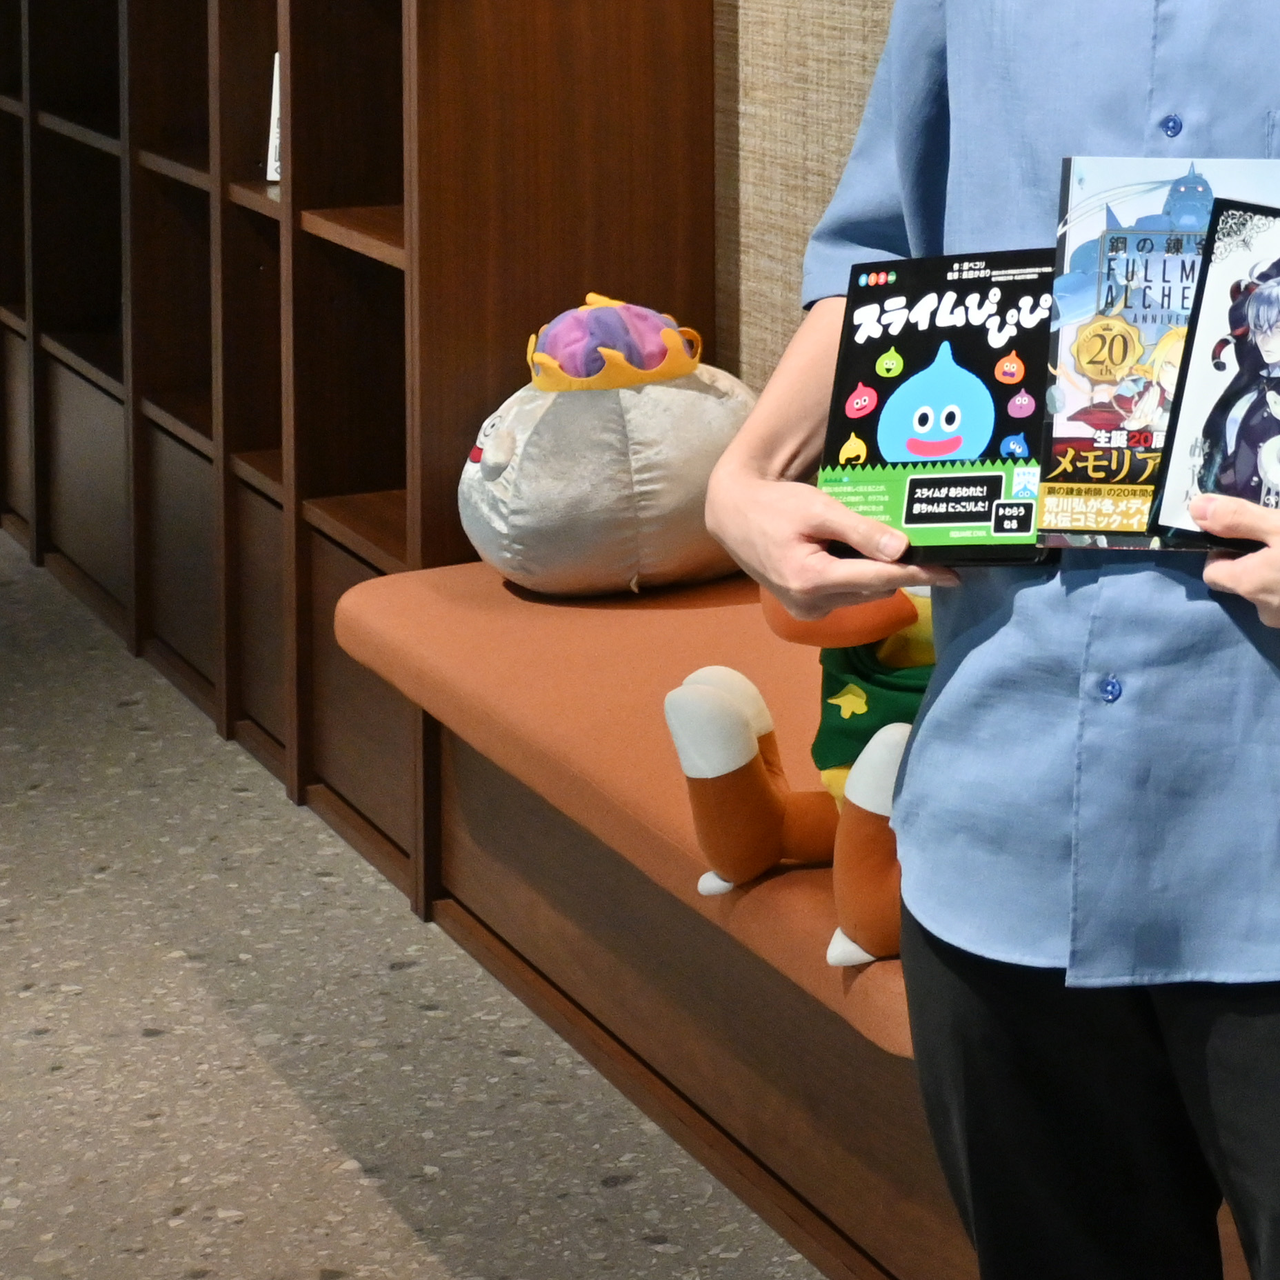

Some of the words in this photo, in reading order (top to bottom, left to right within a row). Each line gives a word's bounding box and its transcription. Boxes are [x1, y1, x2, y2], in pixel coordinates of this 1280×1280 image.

[1106, 258, 1196, 283] FULLM
[1105, 285, 1191, 310] ALCHE
[853, 287, 1053, 349] スライムぴぴぴ
[1086, 333, 1129, 366] 20
[1093, 429, 1166, 449] 生誕20周
[1045, 447, 1162, 483] メモリア
